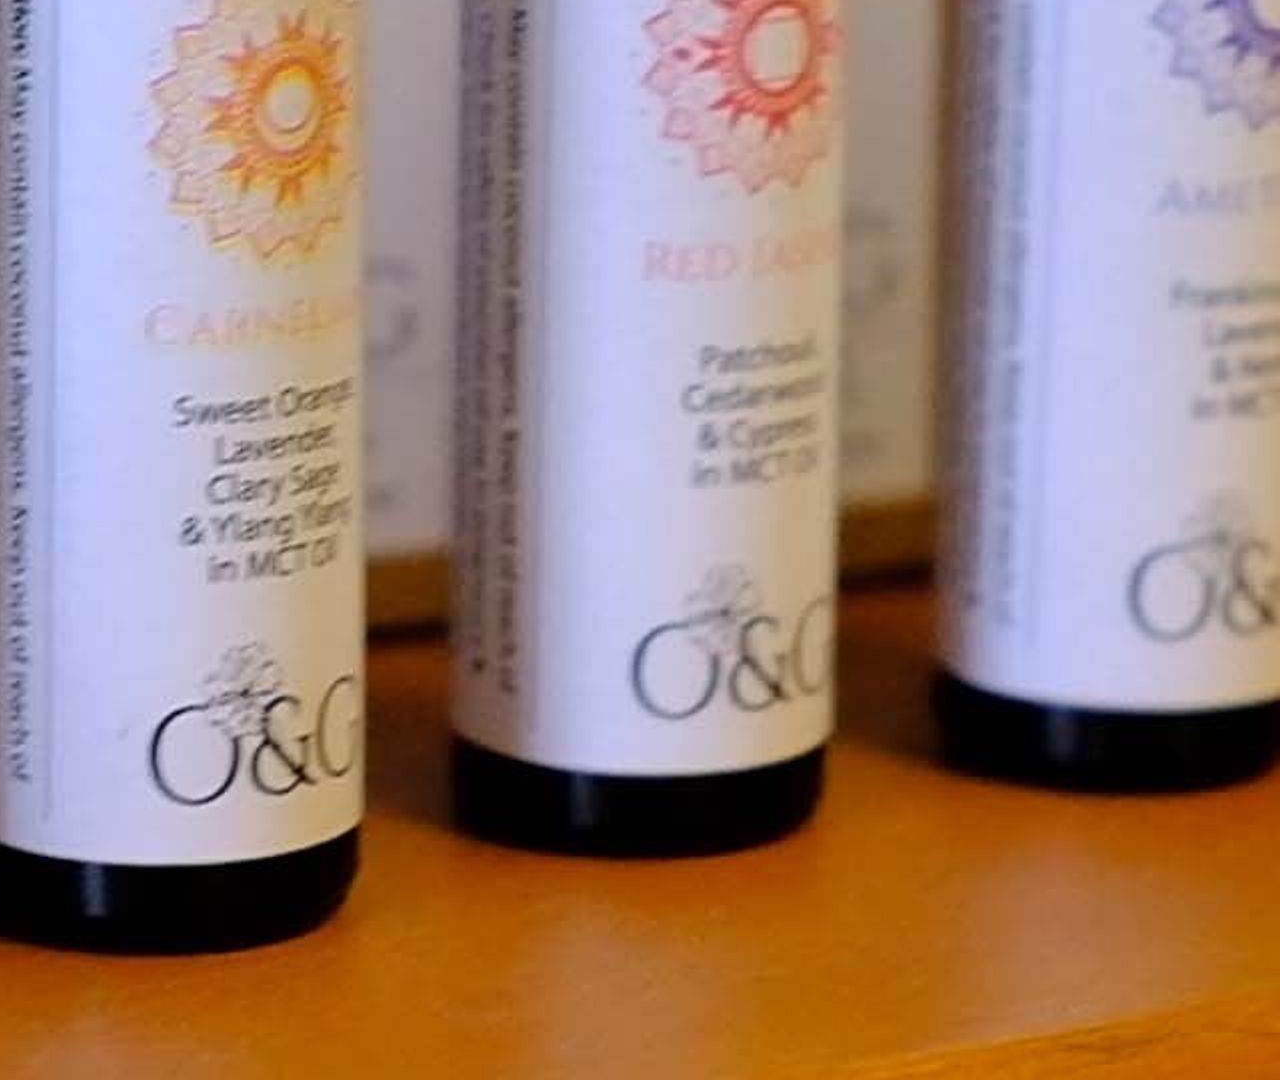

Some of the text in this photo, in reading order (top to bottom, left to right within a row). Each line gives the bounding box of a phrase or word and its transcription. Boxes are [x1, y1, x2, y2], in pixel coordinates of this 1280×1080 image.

[10, 67, 33, 123] May
[11, 131, 32, 237] contain
[641, 240, 739, 282] RED
[10, 242, 31, 358] coconut
[172, 394, 272, 428] Sweet
[206, 470, 282, 508] Clary
[9, 505, 30, 581] Keep
[180, 516, 207, 547] &
[209, 512, 295, 545] Ylang
[207, 556, 239, 585] in
[245, 540, 307, 580] MCT
[11, 581, 30, 627] out
[11, 634, 31, 665] of
